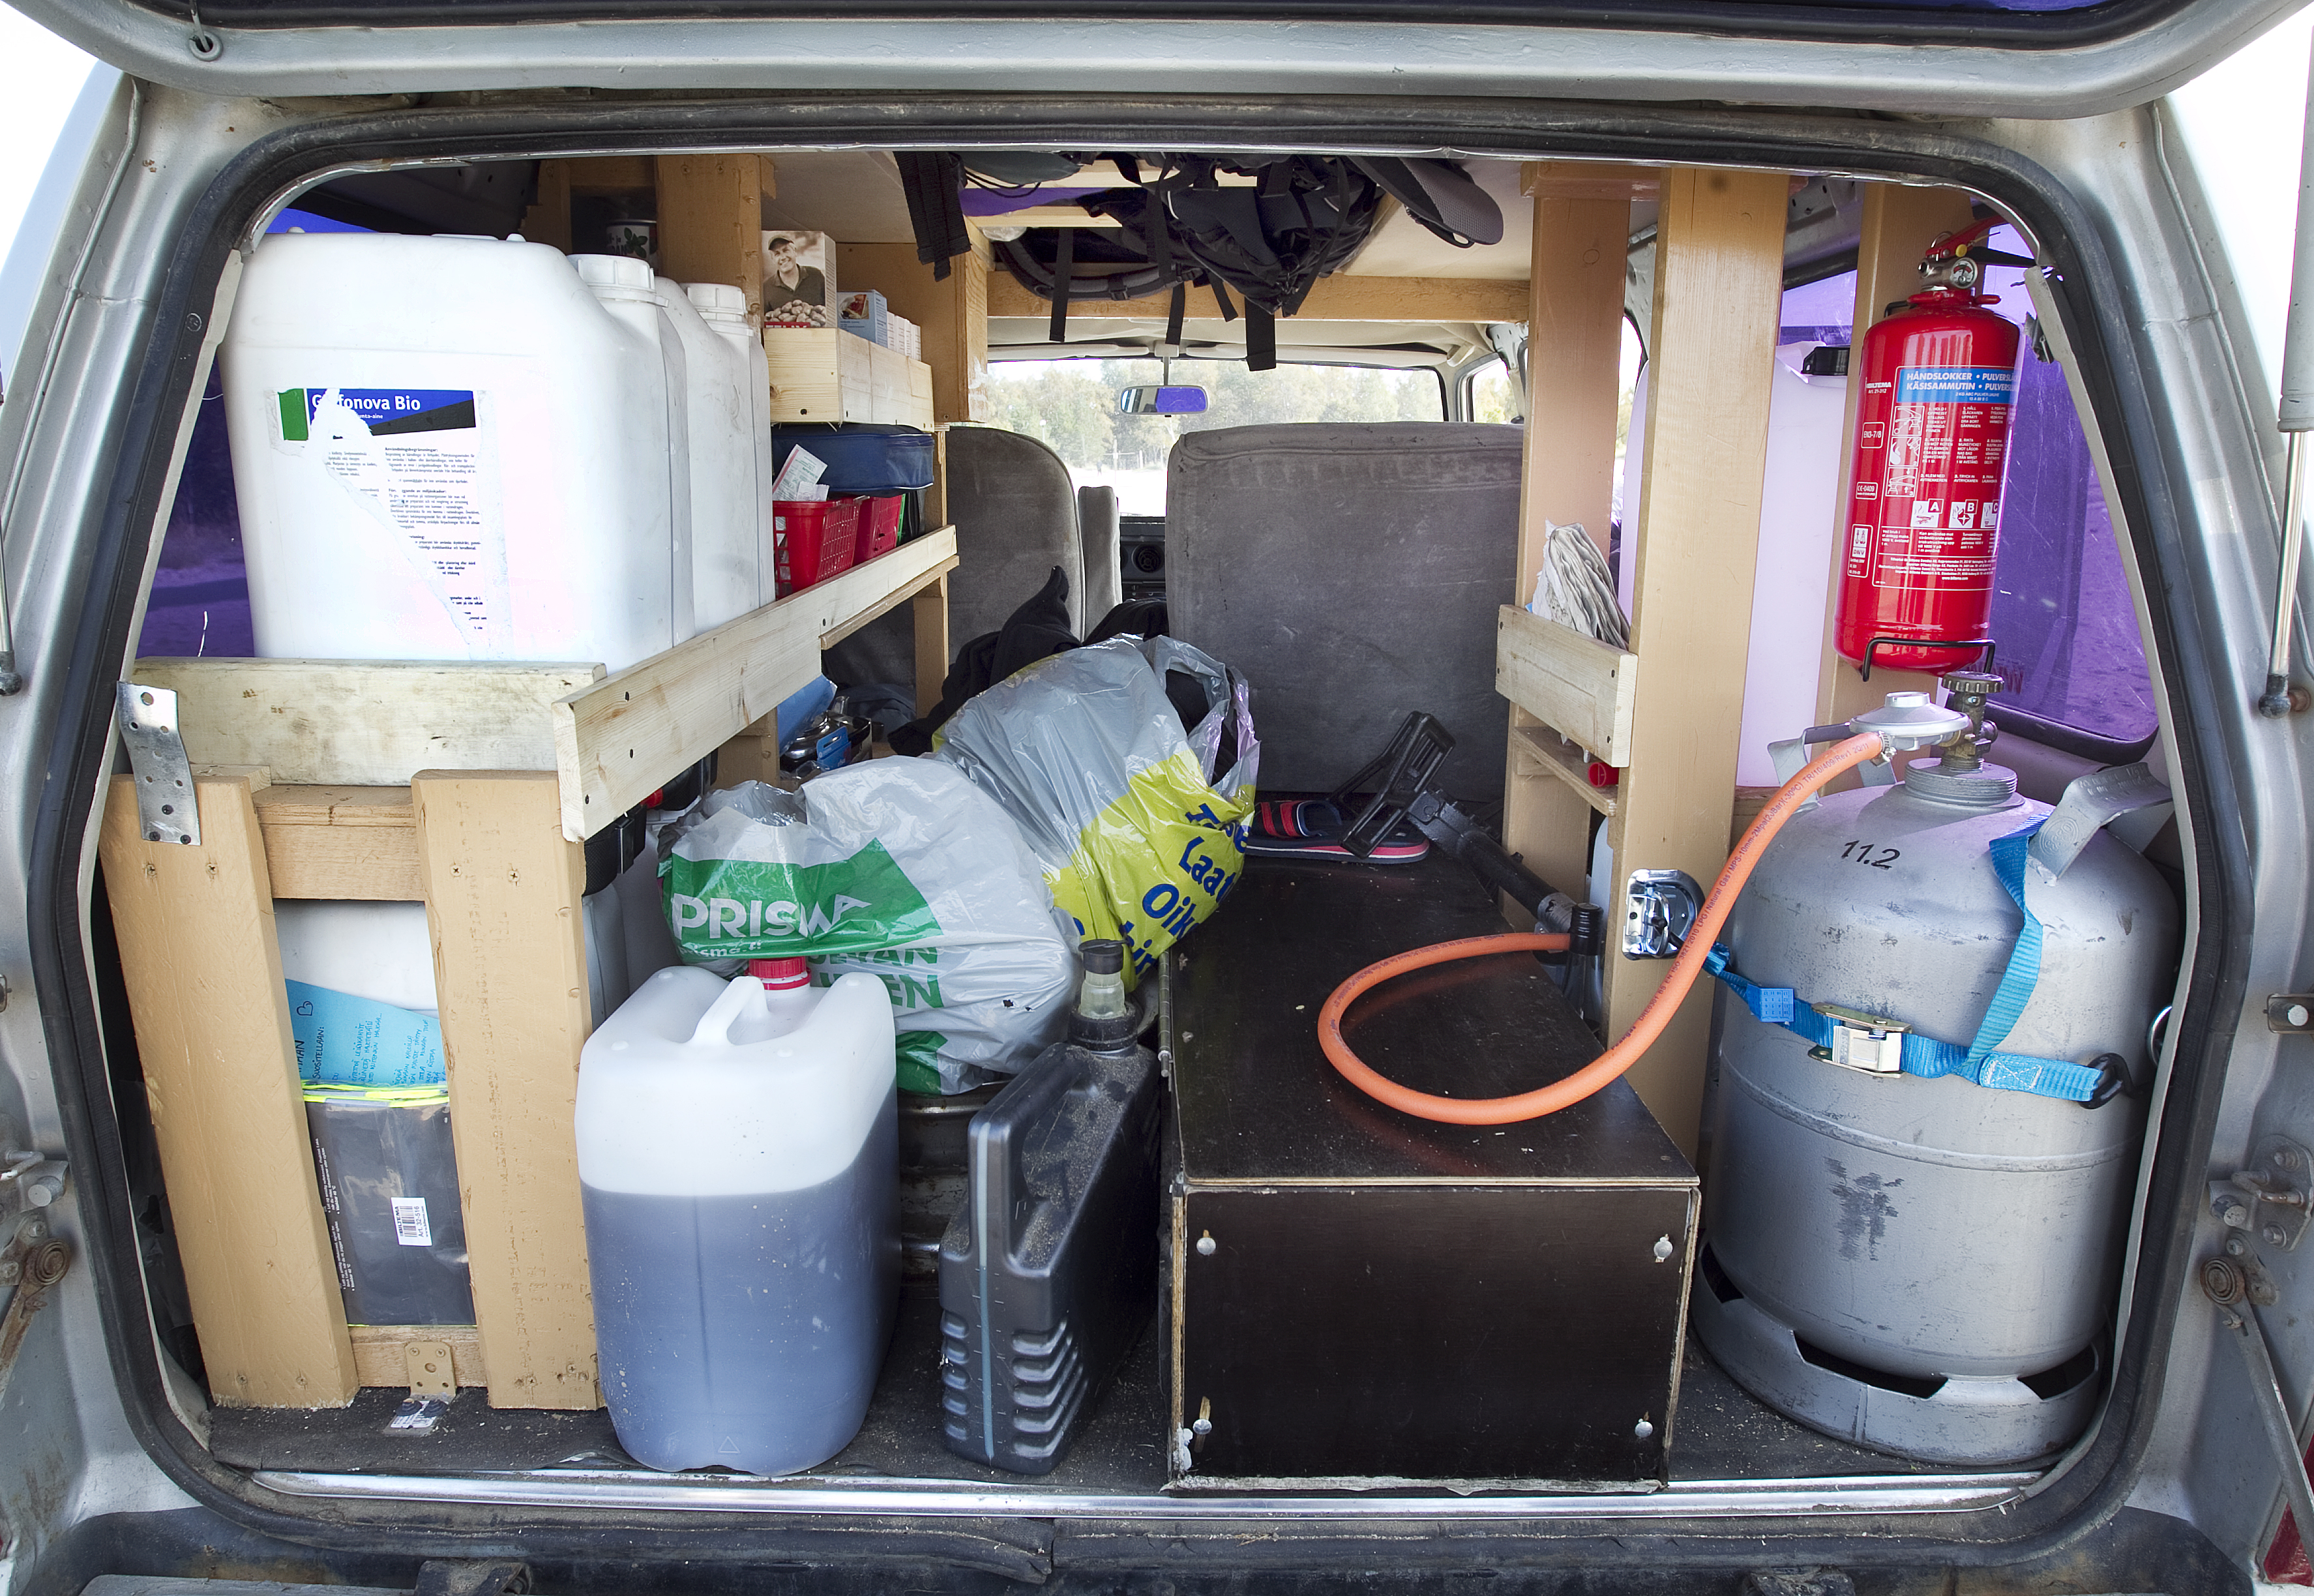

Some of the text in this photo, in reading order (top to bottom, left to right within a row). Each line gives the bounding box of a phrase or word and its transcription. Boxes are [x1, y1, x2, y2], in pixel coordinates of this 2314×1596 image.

[1906, 370, 1972, 380] HÅNDSLOKKER
[1906, 381, 1976, 390] KÄSISAMMUTIN
[312, 394, 421, 411] Gfonova Bio
[1930, 501, 1939, 511] A
[1967, 502, 1974, 511] B
[1841, 840, 1900, 870] 11.2
[672, 893, 872, 940] PRISMA
[312, 1027, 325, 1079] SUOSITELLAAN:
[413, 1206, 422, 1226] 32-516
